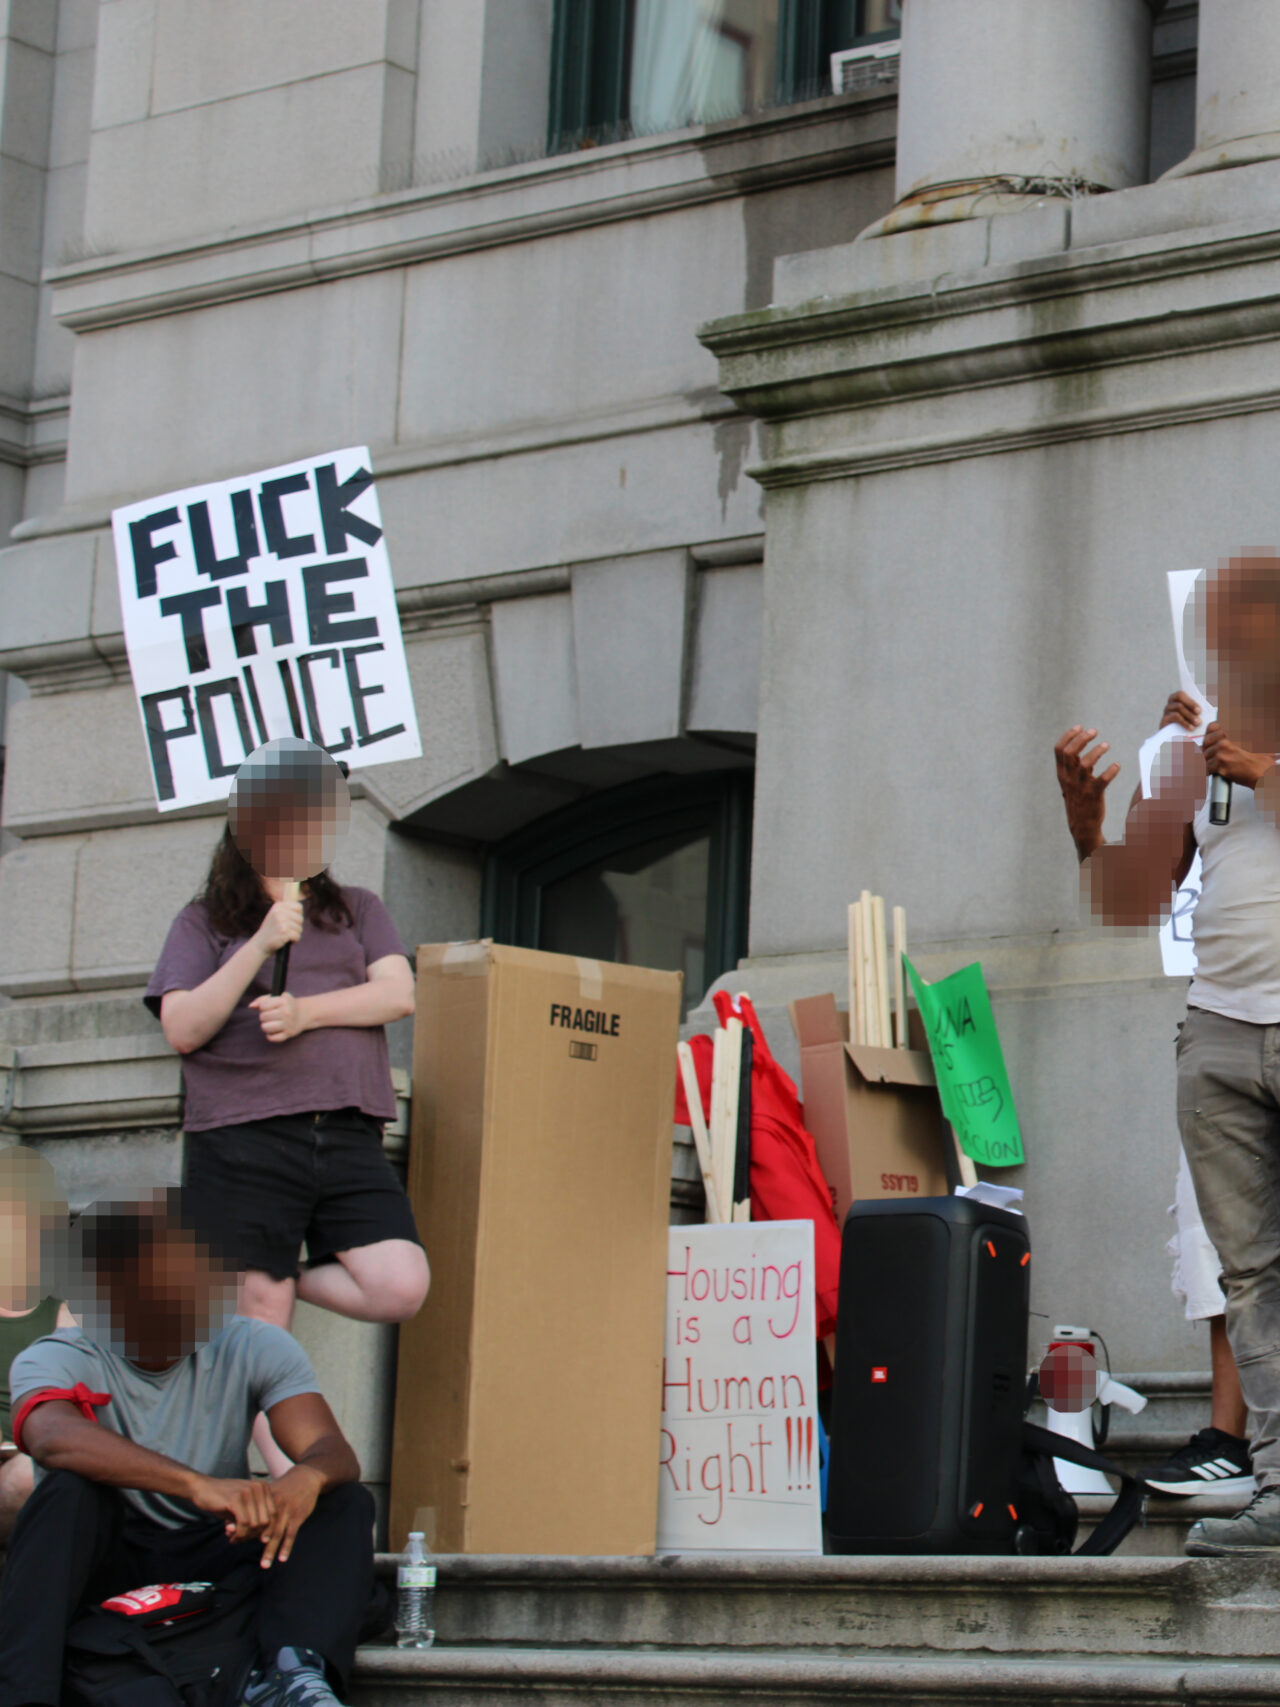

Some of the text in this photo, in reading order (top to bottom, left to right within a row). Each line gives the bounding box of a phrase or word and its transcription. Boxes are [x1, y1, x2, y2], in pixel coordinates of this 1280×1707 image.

[128, 462, 383, 600] FUCK
[160, 556, 380, 675] THE
[550, 1003, 621, 1037] FRAGILE
[880, 1172, 919, 1193] GLASS
[666, 1246, 802, 1339] Housing
[676, 1309, 752, 1345] is a
[661, 1357, 806, 1413] Human
